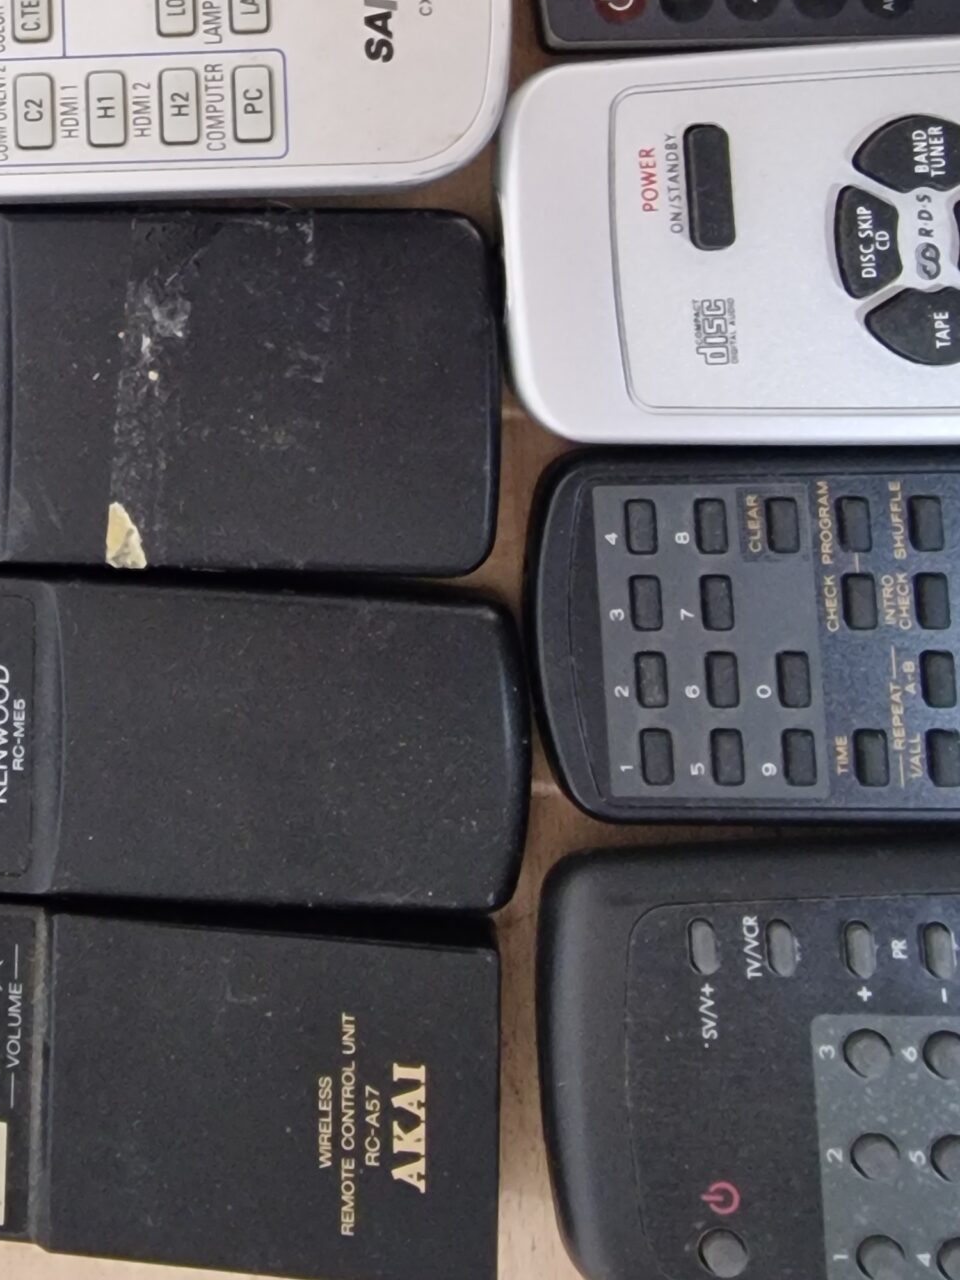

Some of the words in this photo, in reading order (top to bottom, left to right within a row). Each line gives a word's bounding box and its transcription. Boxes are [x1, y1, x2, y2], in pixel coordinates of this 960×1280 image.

[204, 64, 226, 151] COMPUTER
[243, 89, 263, 114] PC
[639, 148, 658, 211] POWER
[912, 130, 929, 173] BAND
[928, 127, 945, 177] TUNER
[665, 133, 684, 233] ON/STANDBY
[857, 207, 874, 238] SKIP
[875, 231, 890, 250] CD
[859, 244, 876, 277] DISC
[933, 312, 951, 348] TAPE
[746, 495, 762, 552] CLEAR
[817, 481, 834, 564] PROGRAM
[889, 482, 907, 559] SHUFFLE
[12, 699, 25, 770] RC-ME5
[835, 736, 848, 774] TIME
[743, 916, 762, 978] TV/VCR
[7, 983, 22, 1067] VOLUME
[342, 1013, 355, 1054] UNIT
[699, 984, 717, 1039] SV/V+
[319, 1077, 332, 1168] WIRELESS
[341, 1061, 355, 1150] CONTROL
[365, 1085, 380, 1166] RC-A57
[391, 1063, 425, 1193] AKAI
[341, 1158, 355, 1235] REMOTE
